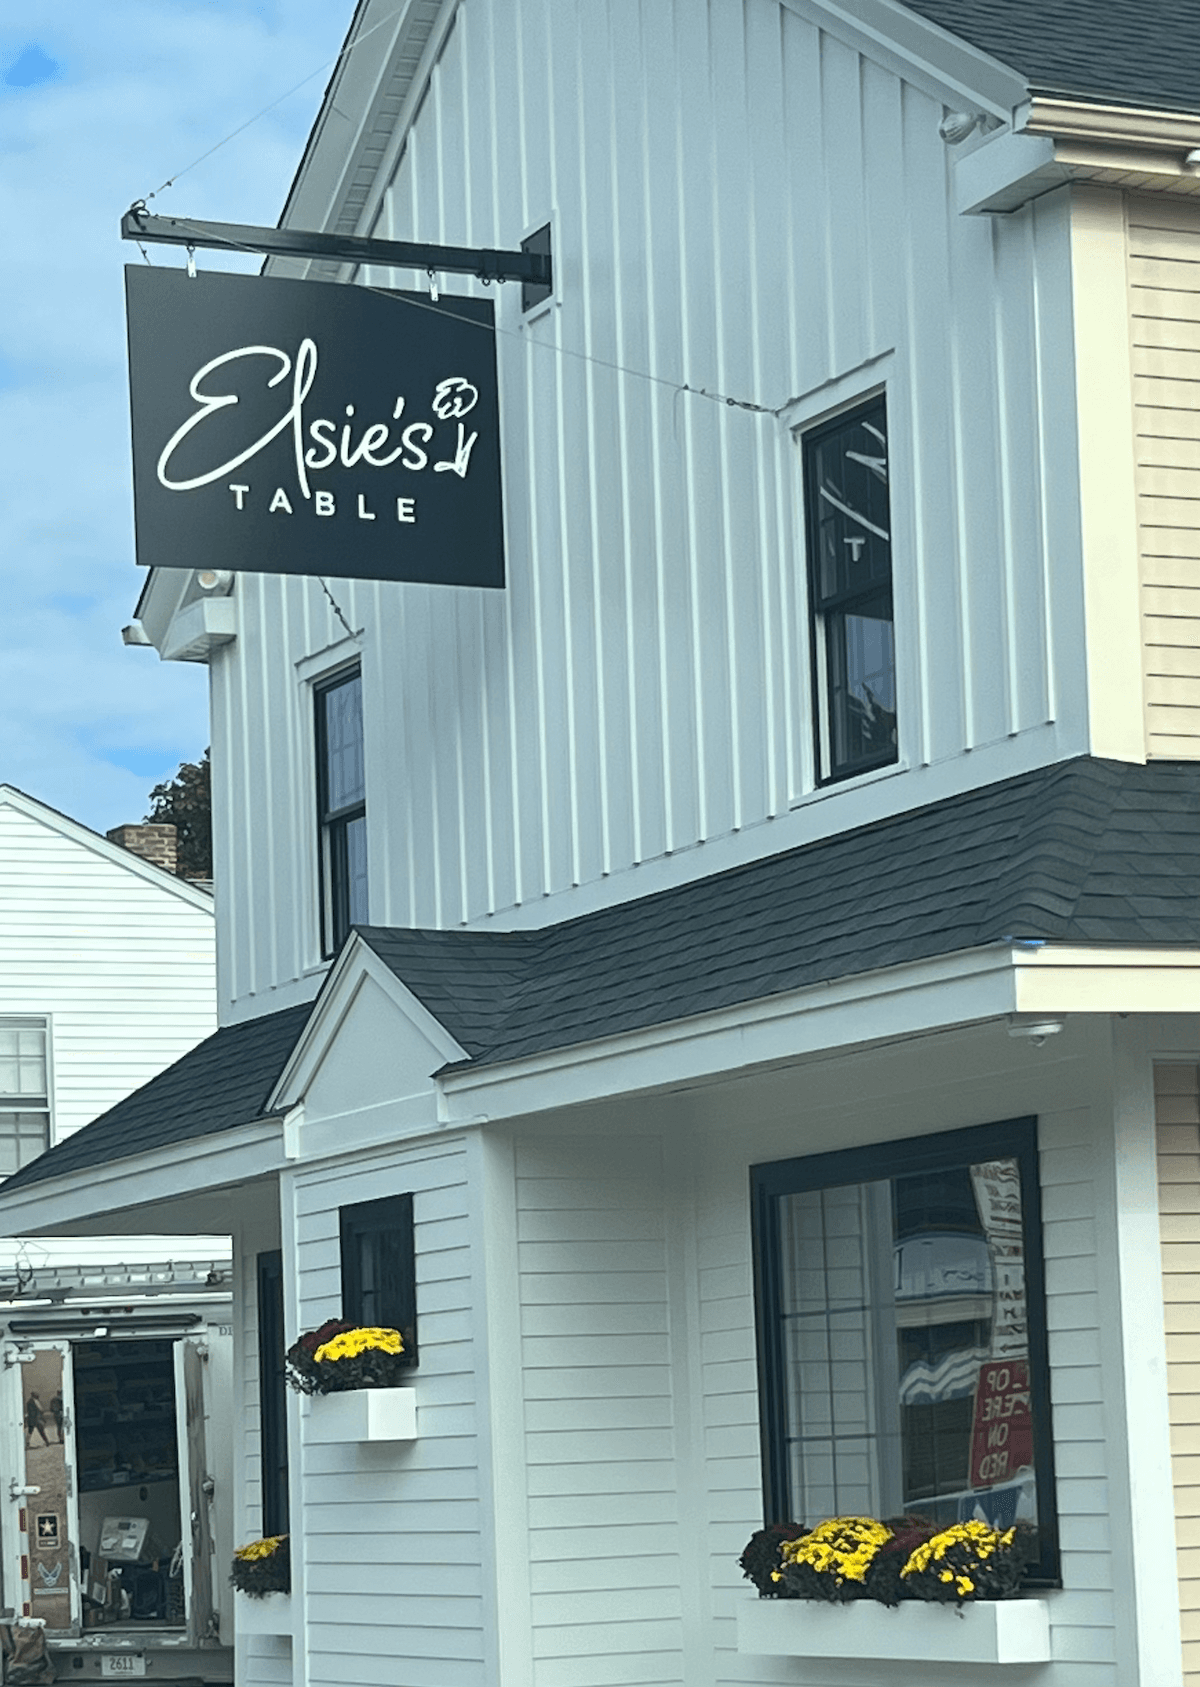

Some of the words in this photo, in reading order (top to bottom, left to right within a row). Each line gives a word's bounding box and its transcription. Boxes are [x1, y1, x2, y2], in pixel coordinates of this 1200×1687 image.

[157, 338, 433, 499] Elsie's
[229, 484, 416, 523] TABLE
[109, 1656, 134, 1671] 2611
